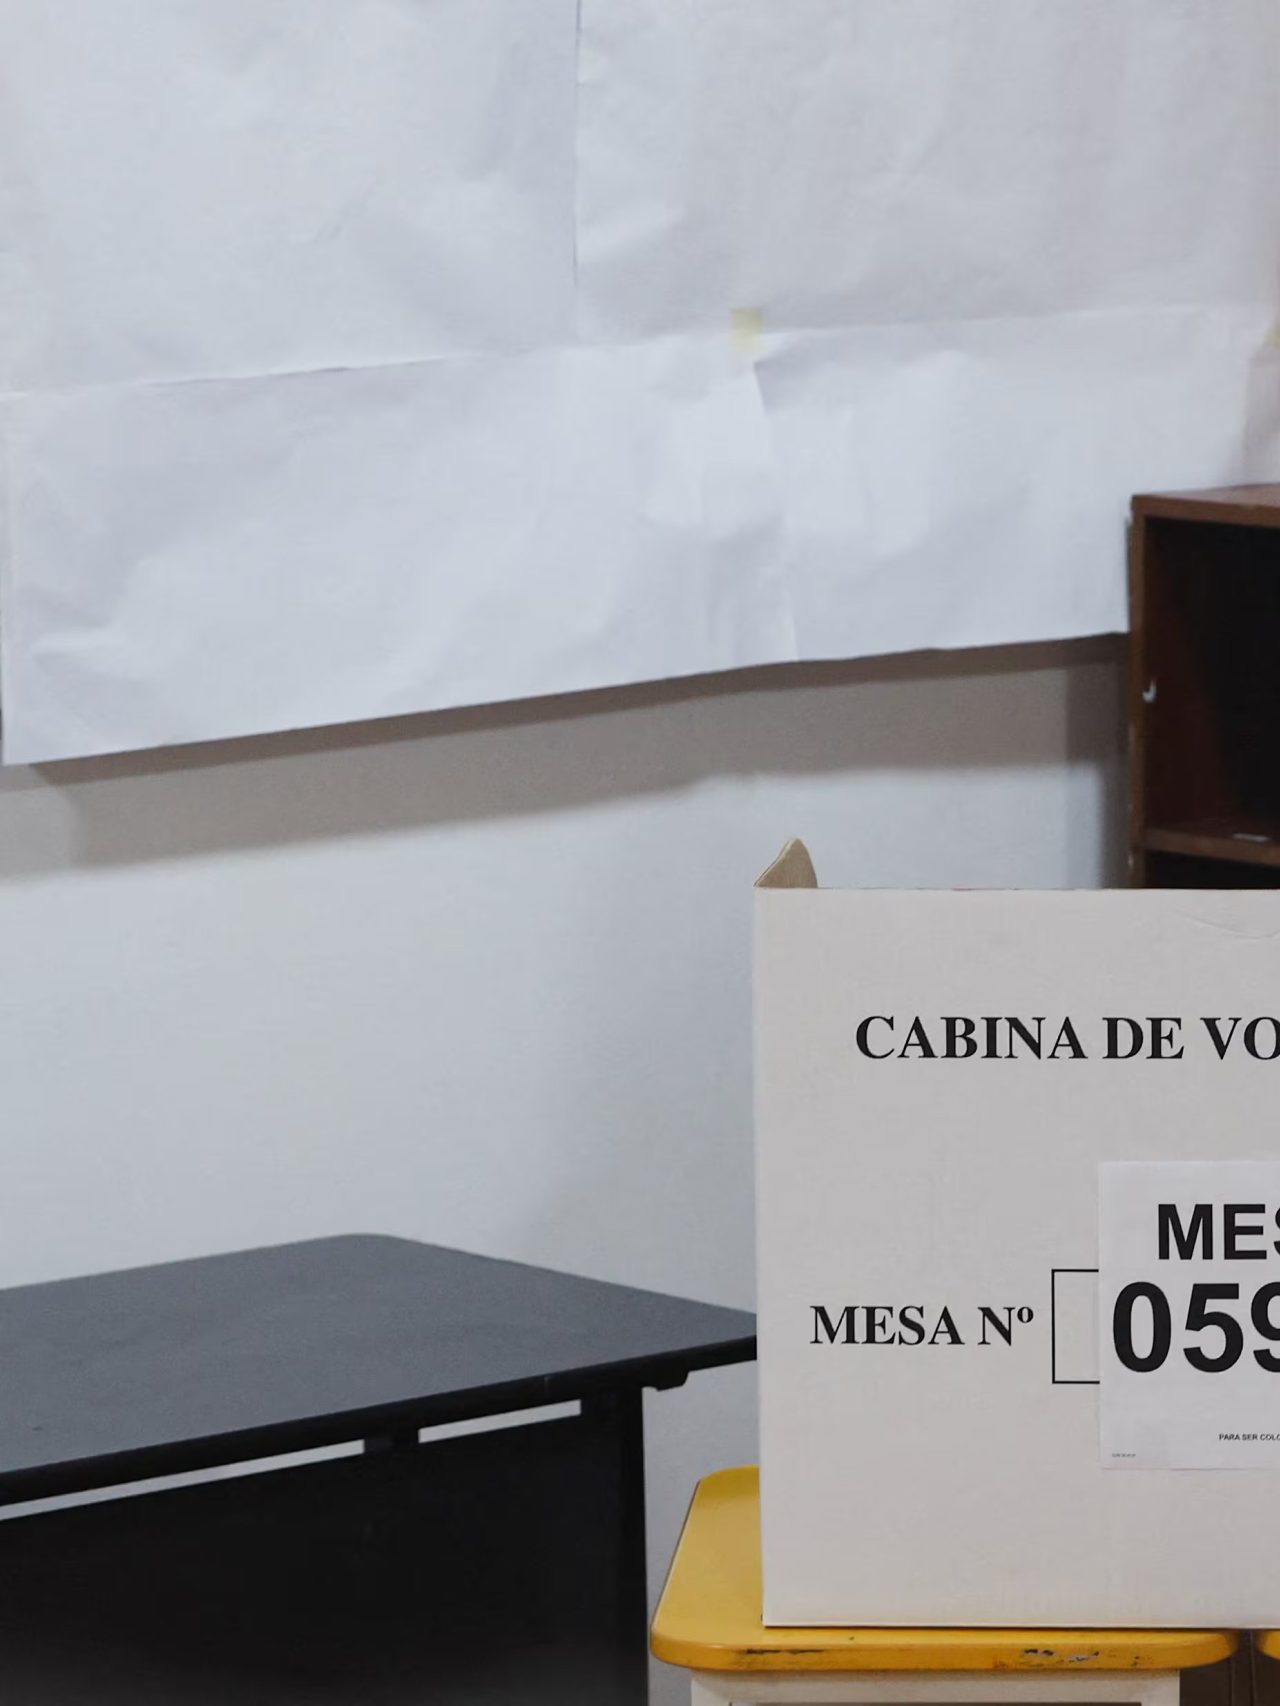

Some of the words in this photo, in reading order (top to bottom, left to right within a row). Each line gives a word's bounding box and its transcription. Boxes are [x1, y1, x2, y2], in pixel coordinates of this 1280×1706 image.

[855, 1015, 1089, 1060] CABINA
[1101, 1016, 1185, 1060] DE
[809, 1305, 966, 1346] MESA
[1218, 1433, 1241, 1441] PARA
[1241, 1433, 1258, 1441] SER
